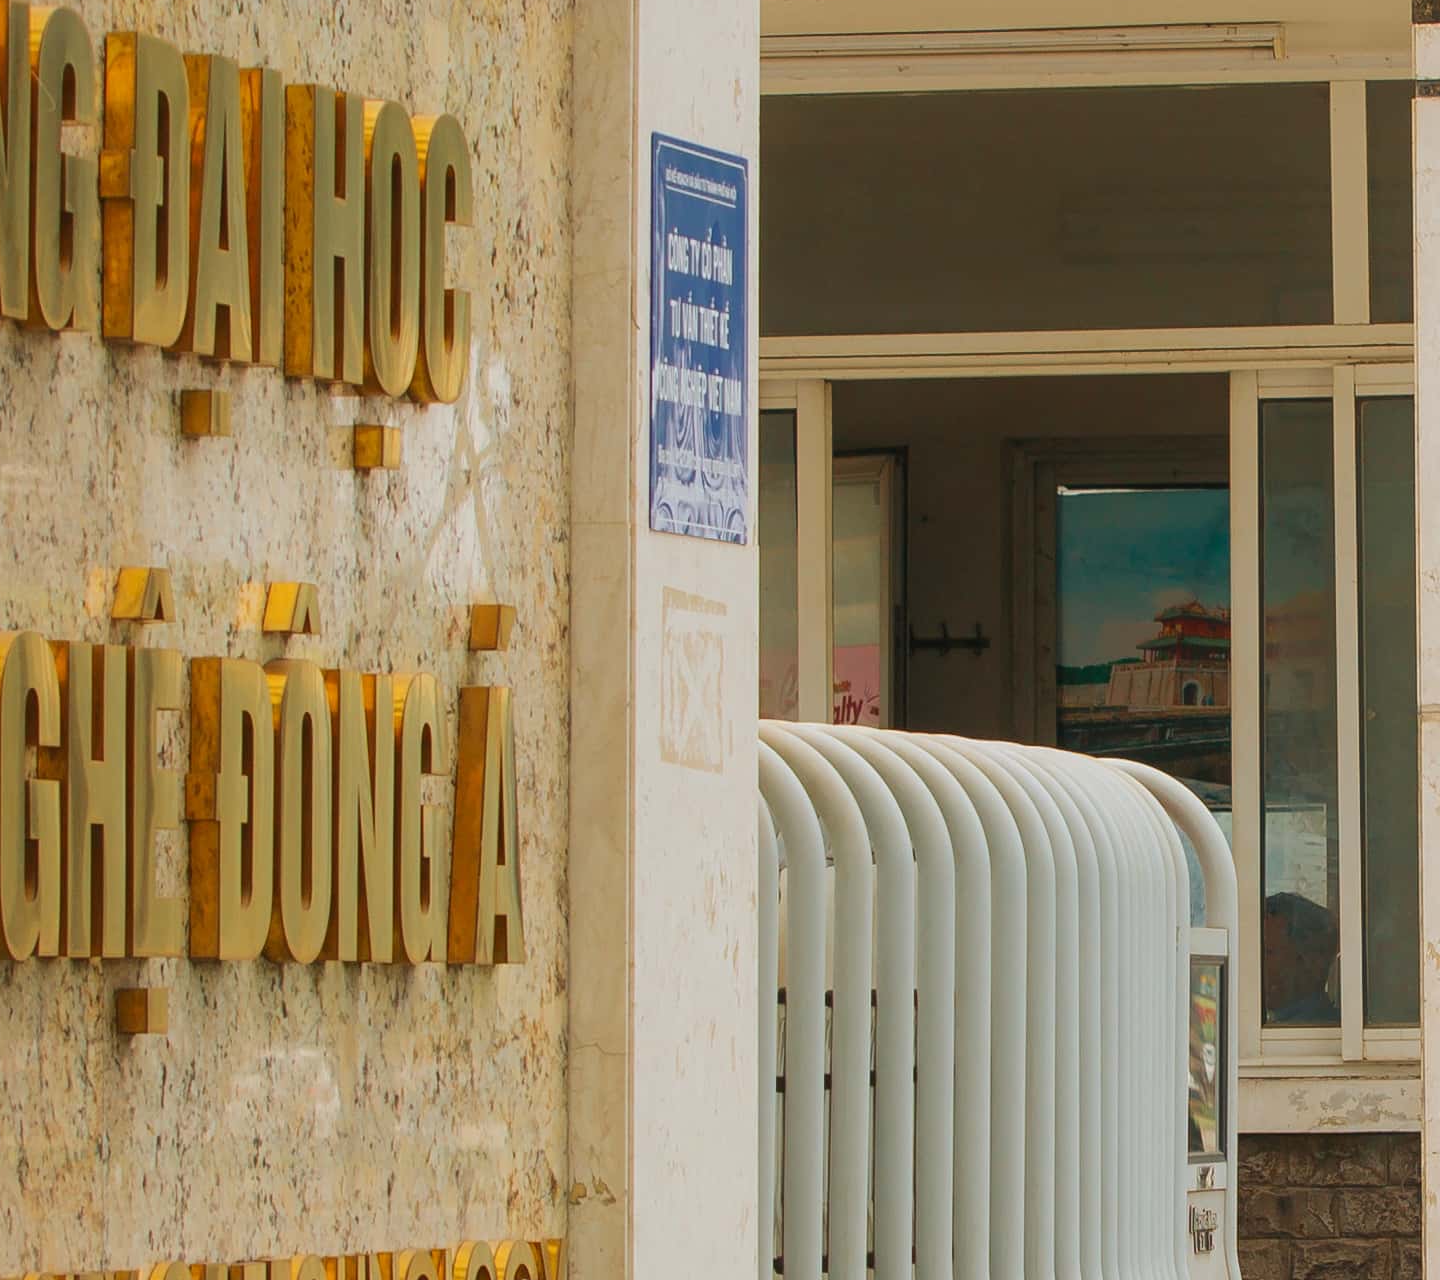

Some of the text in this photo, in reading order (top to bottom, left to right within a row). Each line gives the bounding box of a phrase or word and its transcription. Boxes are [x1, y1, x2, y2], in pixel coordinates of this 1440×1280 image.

[100, 30, 282, 437] ĐẠI
[284, 83, 472, 470] HỌC
[185, 580, 448, 965] ĐÔNG
[446, 602, 524, 965] Á
